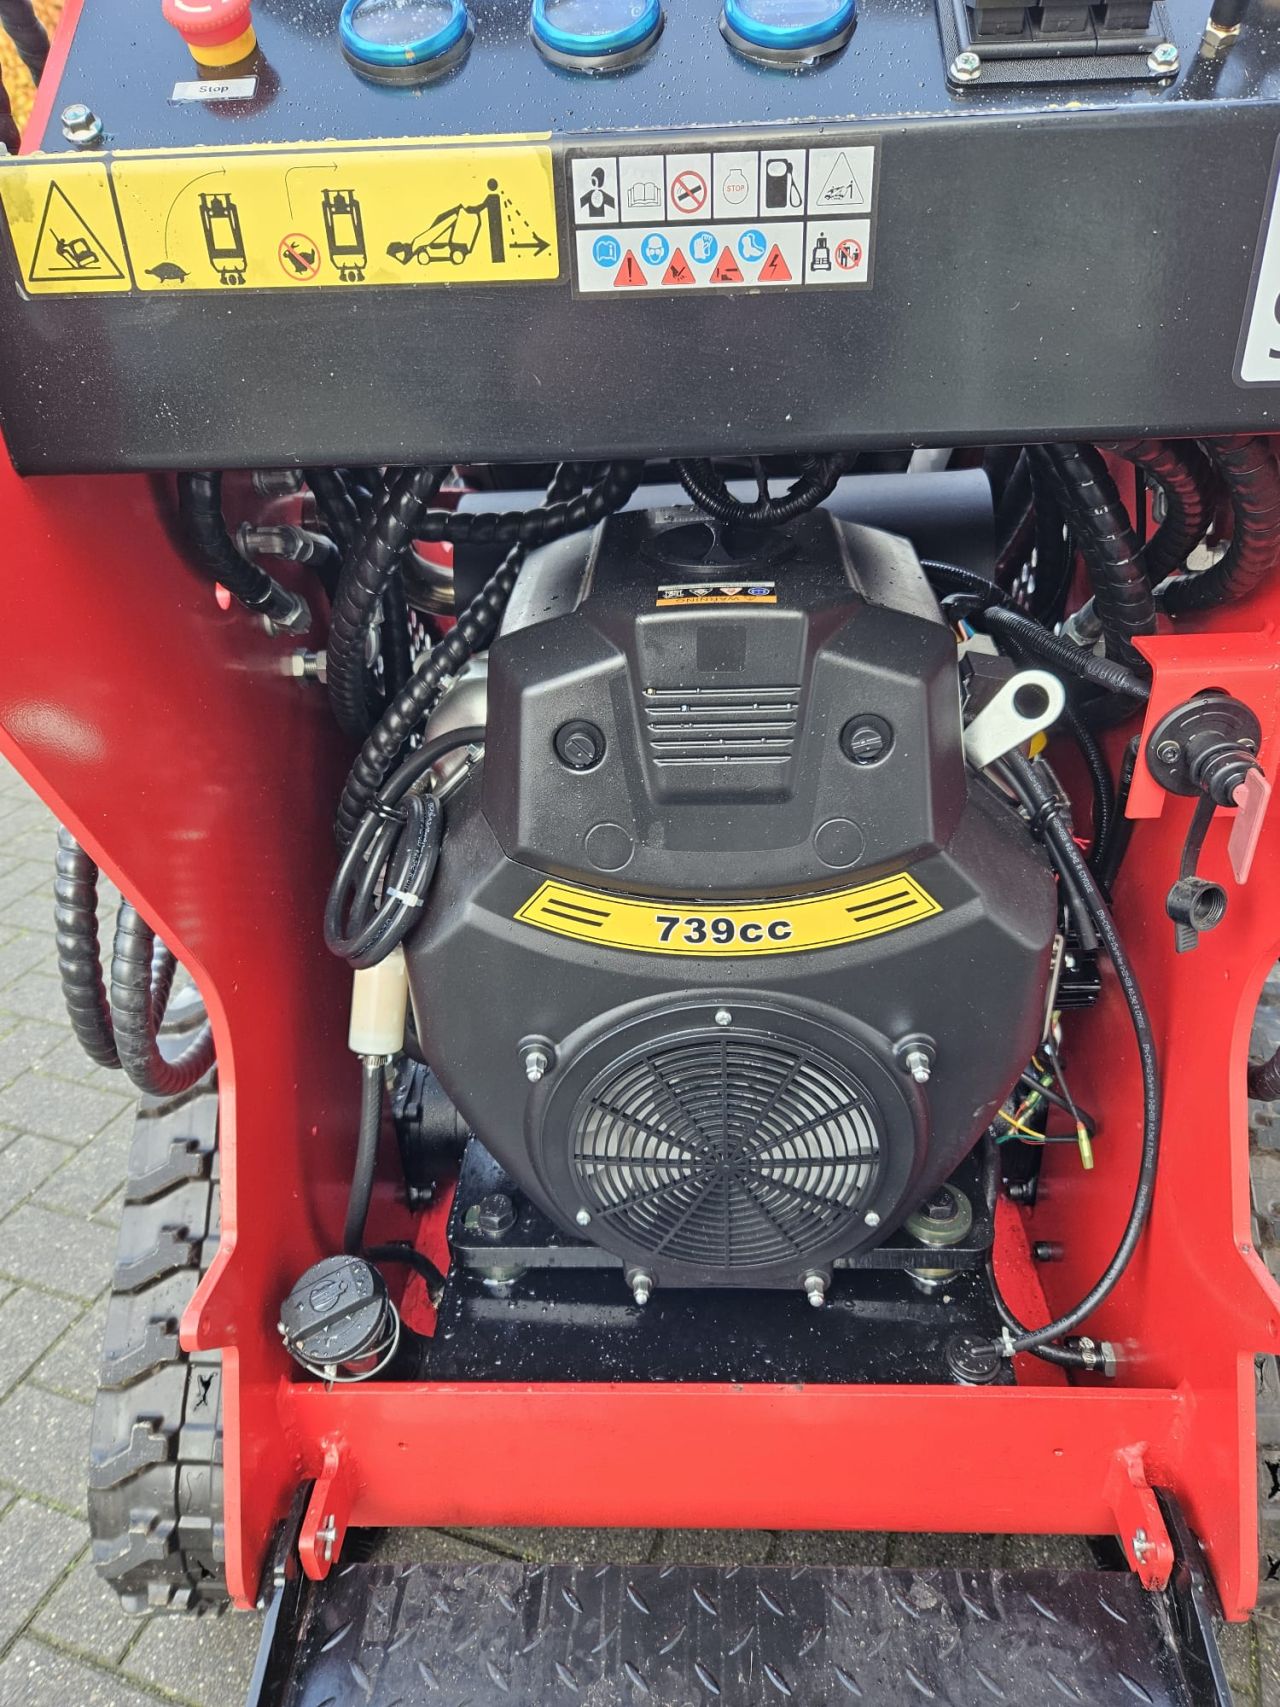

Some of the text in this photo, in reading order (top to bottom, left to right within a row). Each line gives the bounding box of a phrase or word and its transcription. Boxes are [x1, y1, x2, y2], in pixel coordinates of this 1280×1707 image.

[199, 85, 229, 93] Stop
[726, 184, 745, 193] STOP
[675, 595, 740, 604] WARNING
[655, 915, 793, 944] 739cc
